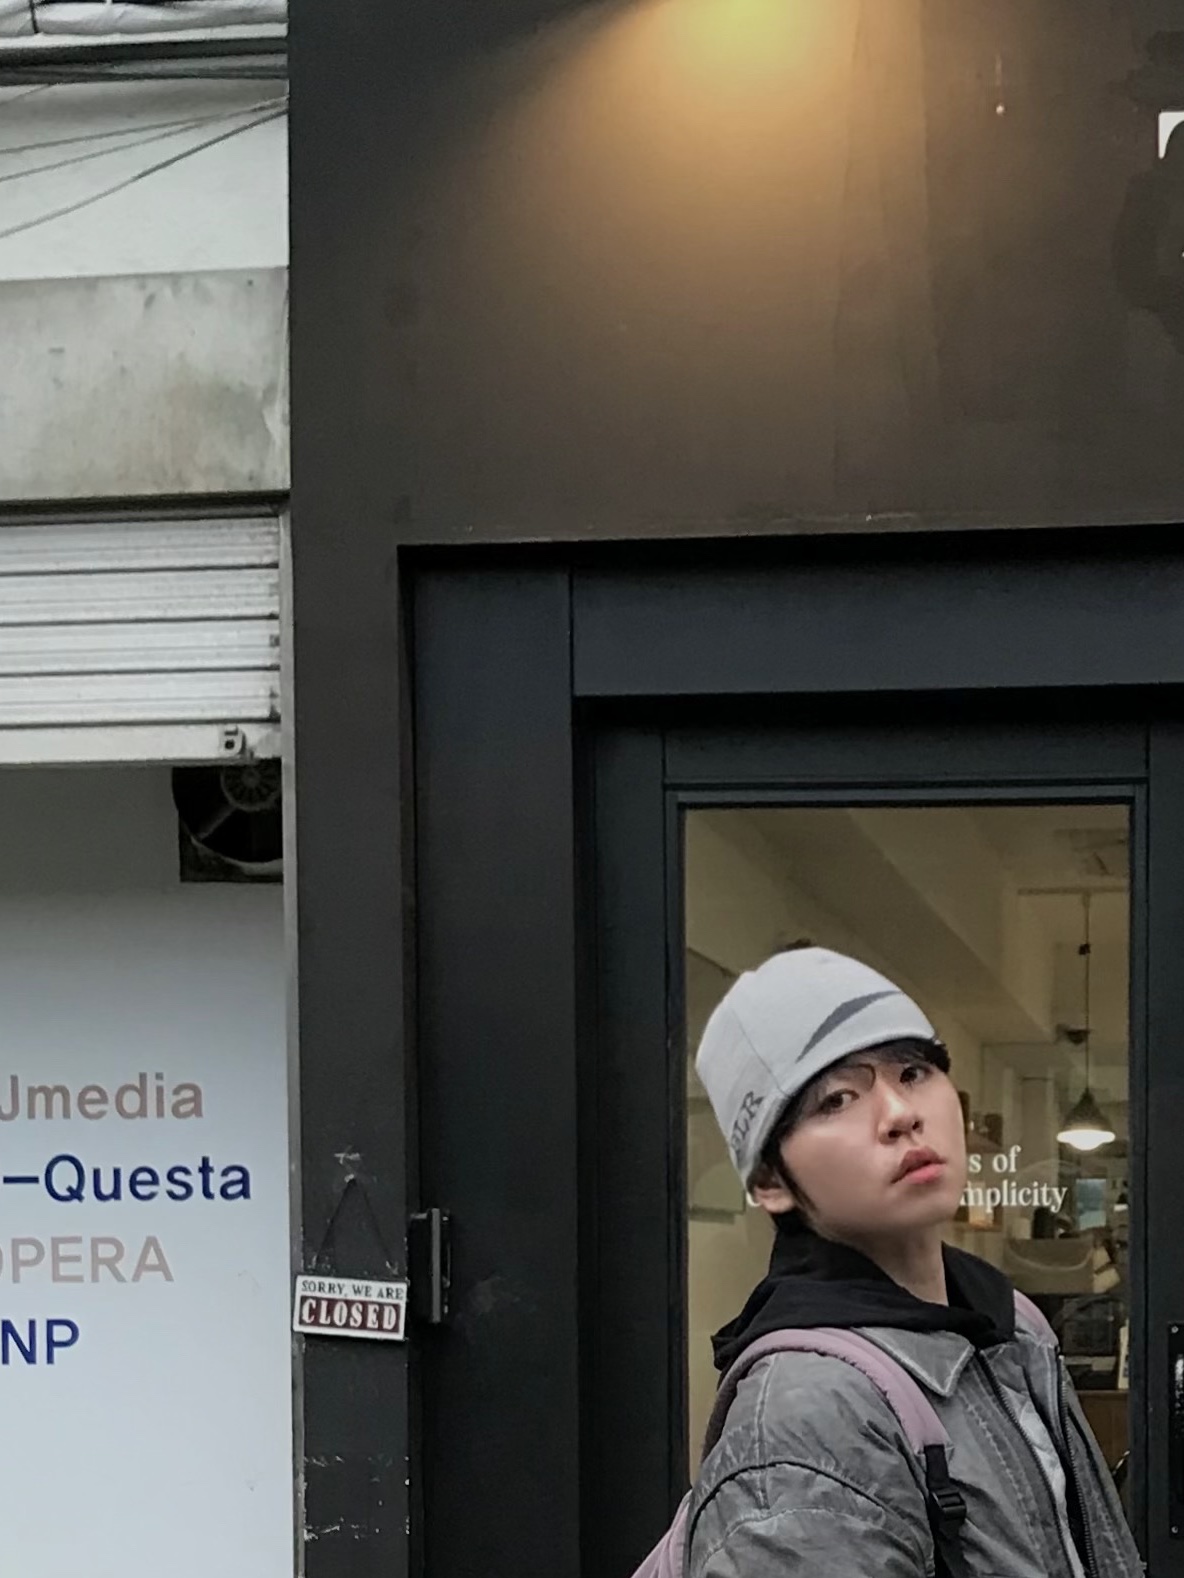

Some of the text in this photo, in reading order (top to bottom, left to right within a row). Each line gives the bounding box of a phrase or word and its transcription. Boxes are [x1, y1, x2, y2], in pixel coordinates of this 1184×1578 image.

[991, 1144, 1023, 1174] of
[0, 1235, 175, 1285] PERA
[301, 1280, 404, 1301] SORRY, WE ARE
[301, 1298, 397, 1331] CLOSED
